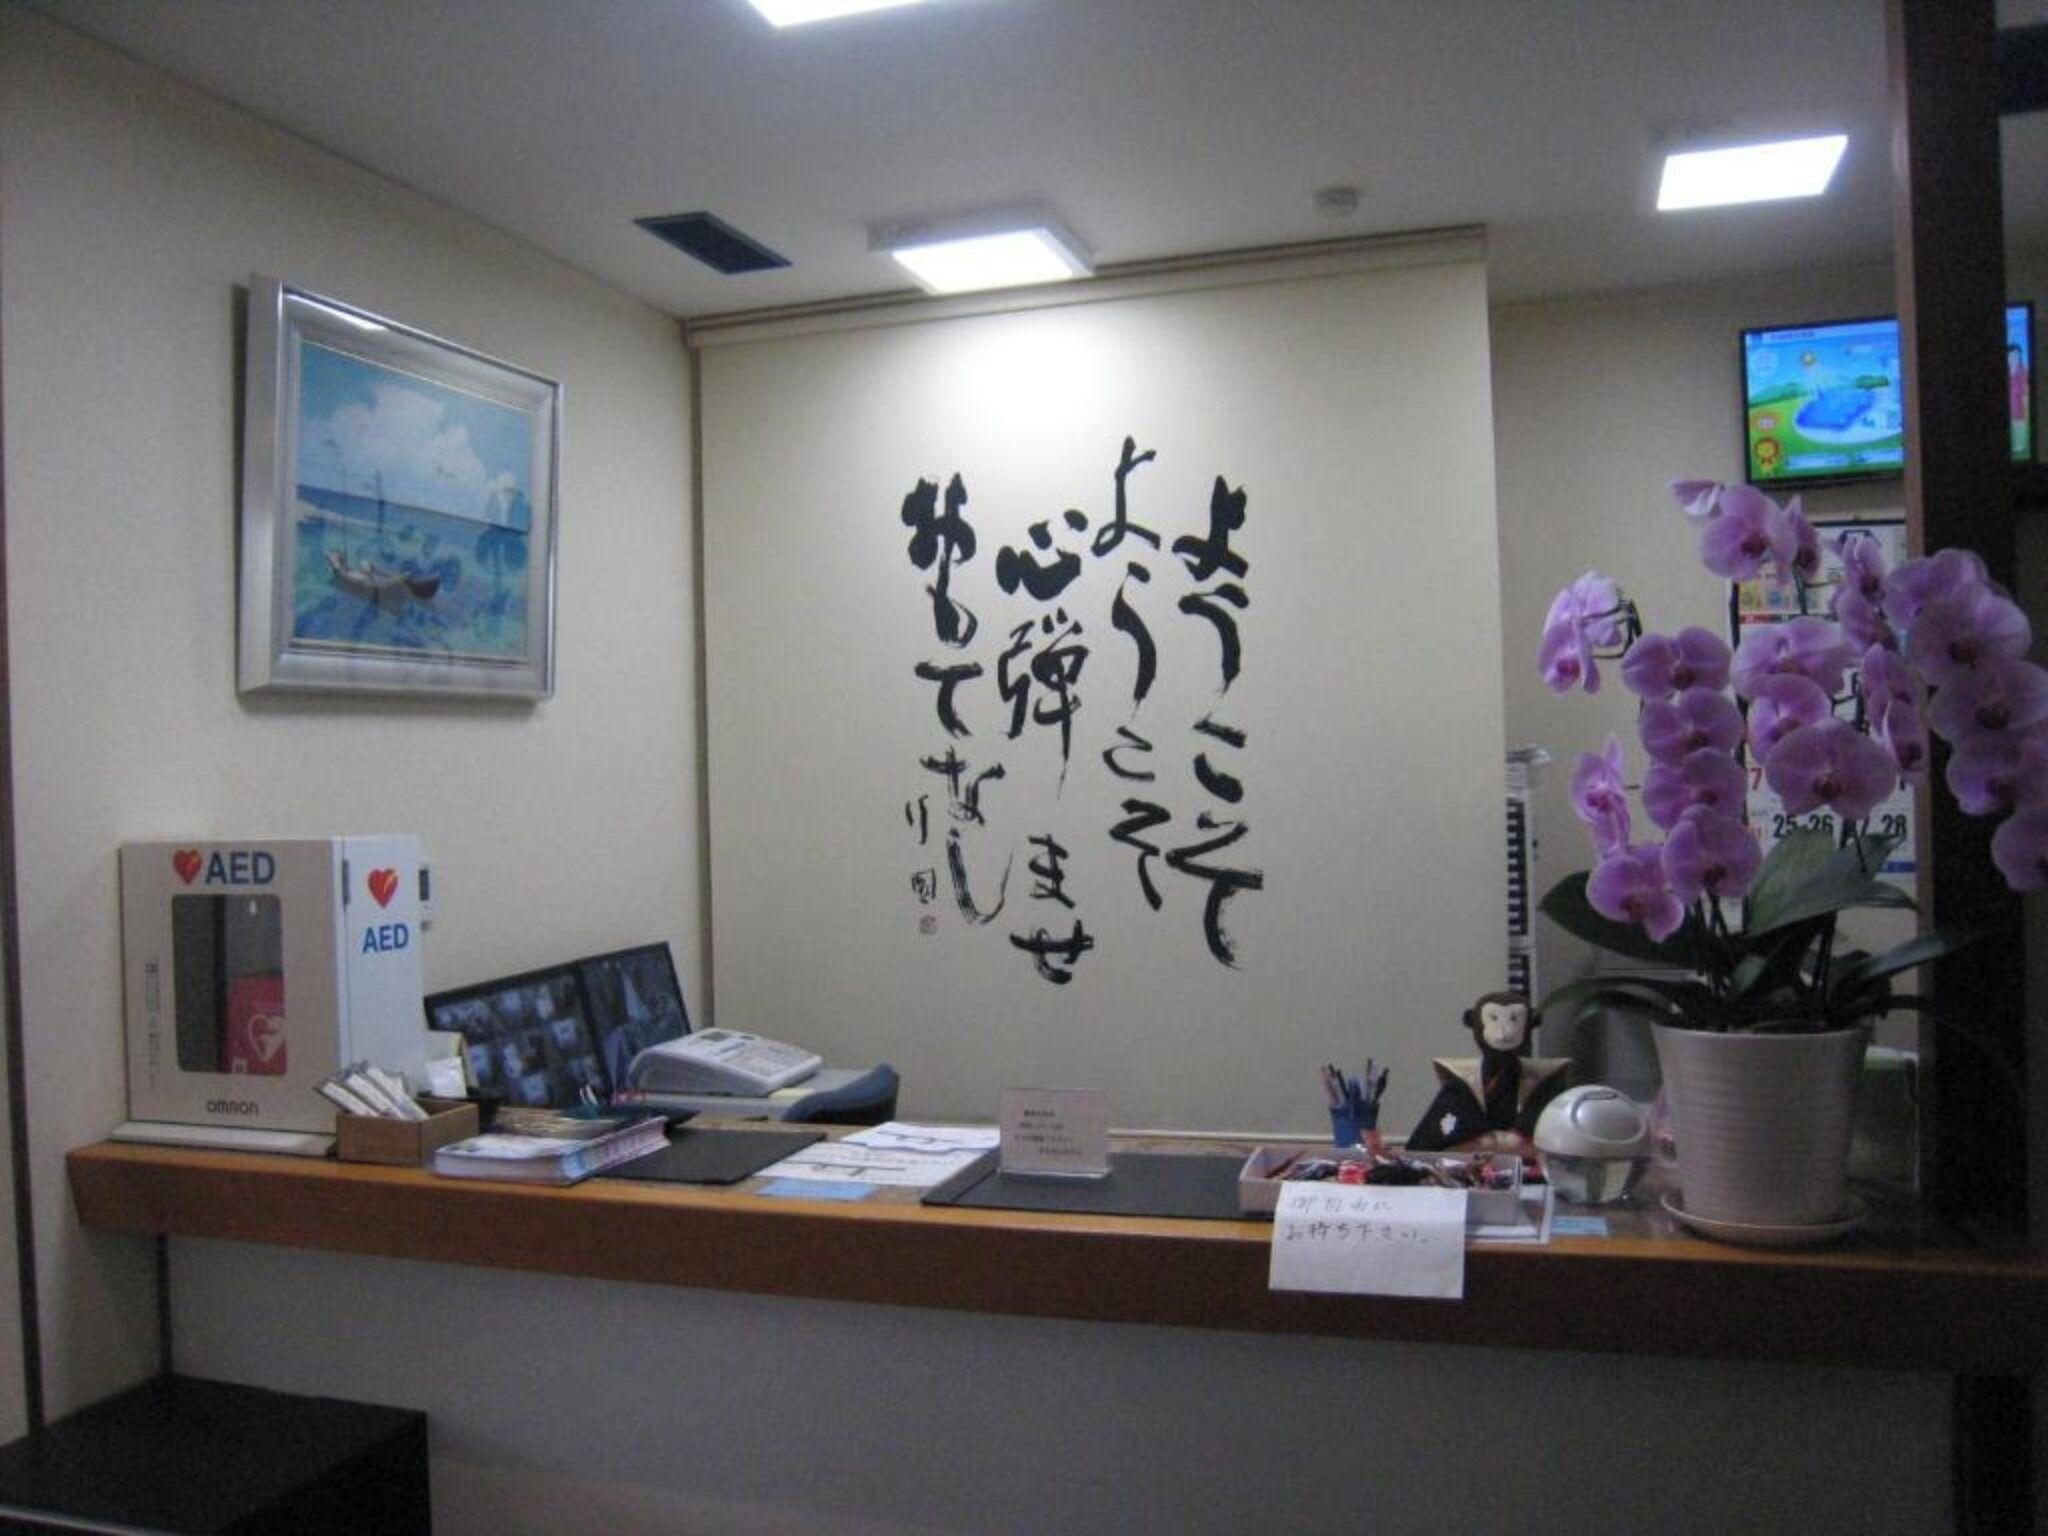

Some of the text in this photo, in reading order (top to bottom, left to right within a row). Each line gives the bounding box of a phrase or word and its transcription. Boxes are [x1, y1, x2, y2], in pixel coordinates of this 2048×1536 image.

[996, 508, 1095, 985] 心弾ませ
[1091, 435, 1171, 911] ようこそ
[205, 852, 275, 885] AED
[362, 924, 409, 954] AED
